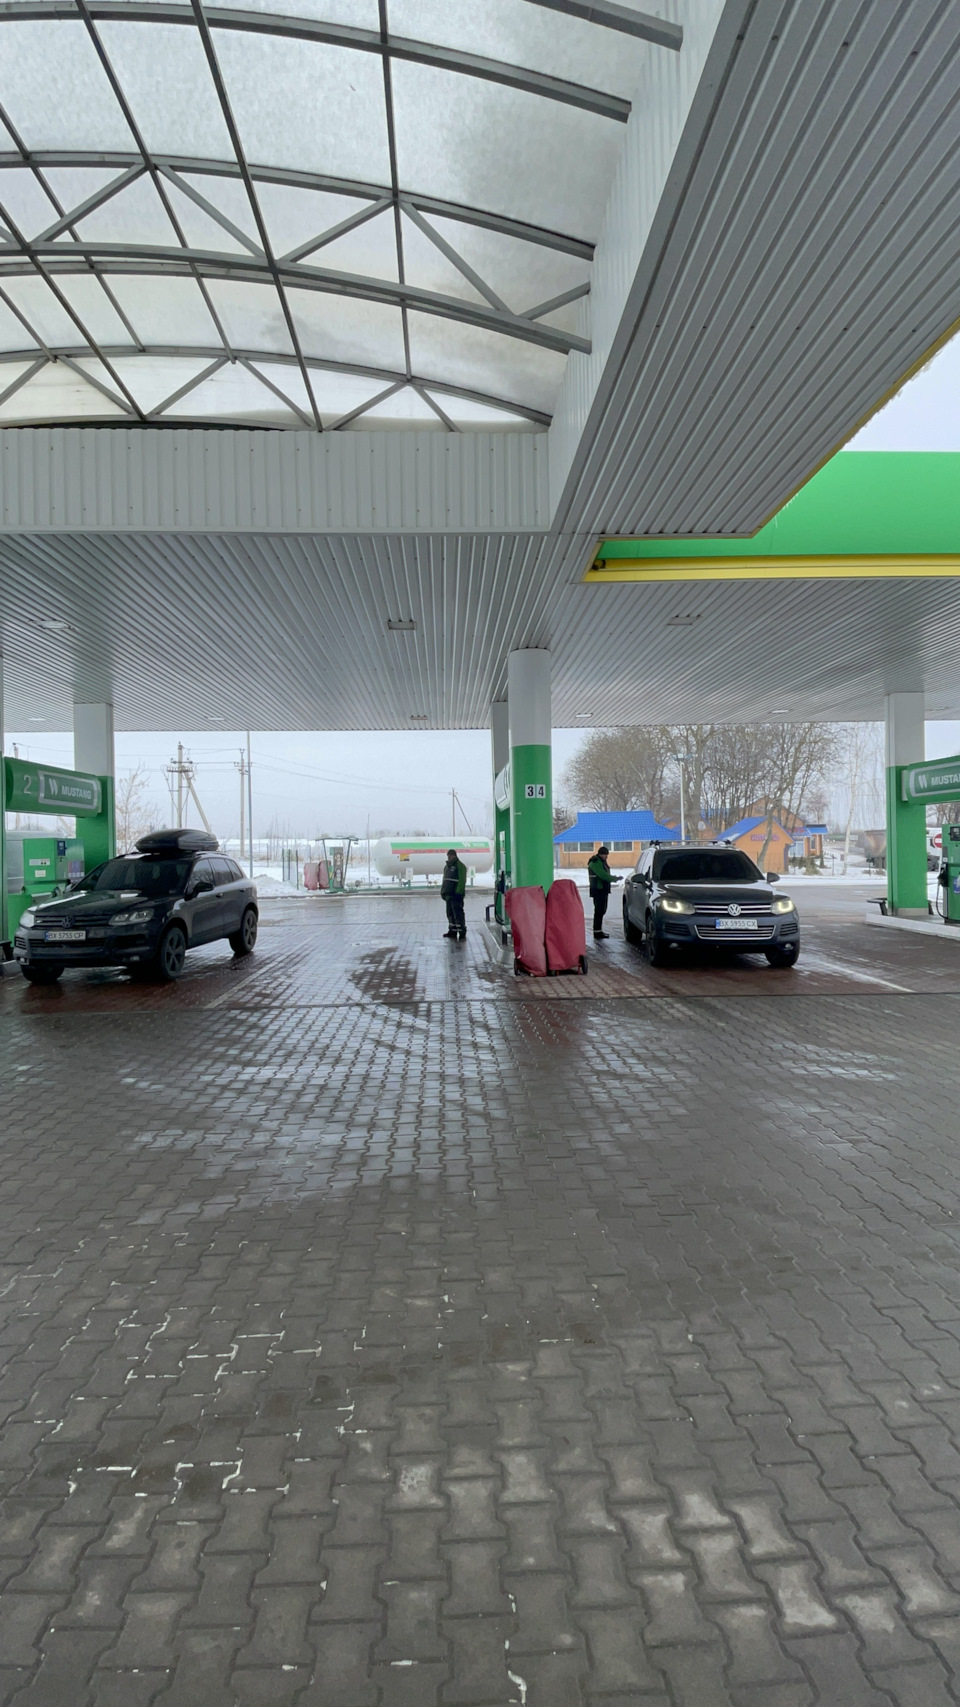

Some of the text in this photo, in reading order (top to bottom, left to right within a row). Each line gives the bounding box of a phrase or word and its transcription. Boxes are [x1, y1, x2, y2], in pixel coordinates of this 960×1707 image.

[931, 774, 960, 786] MUSTA
[23, 775, 32, 794] 2
[61, 785, 92, 799] MUSTANG
[527, 785, 544, 797] 3 4
